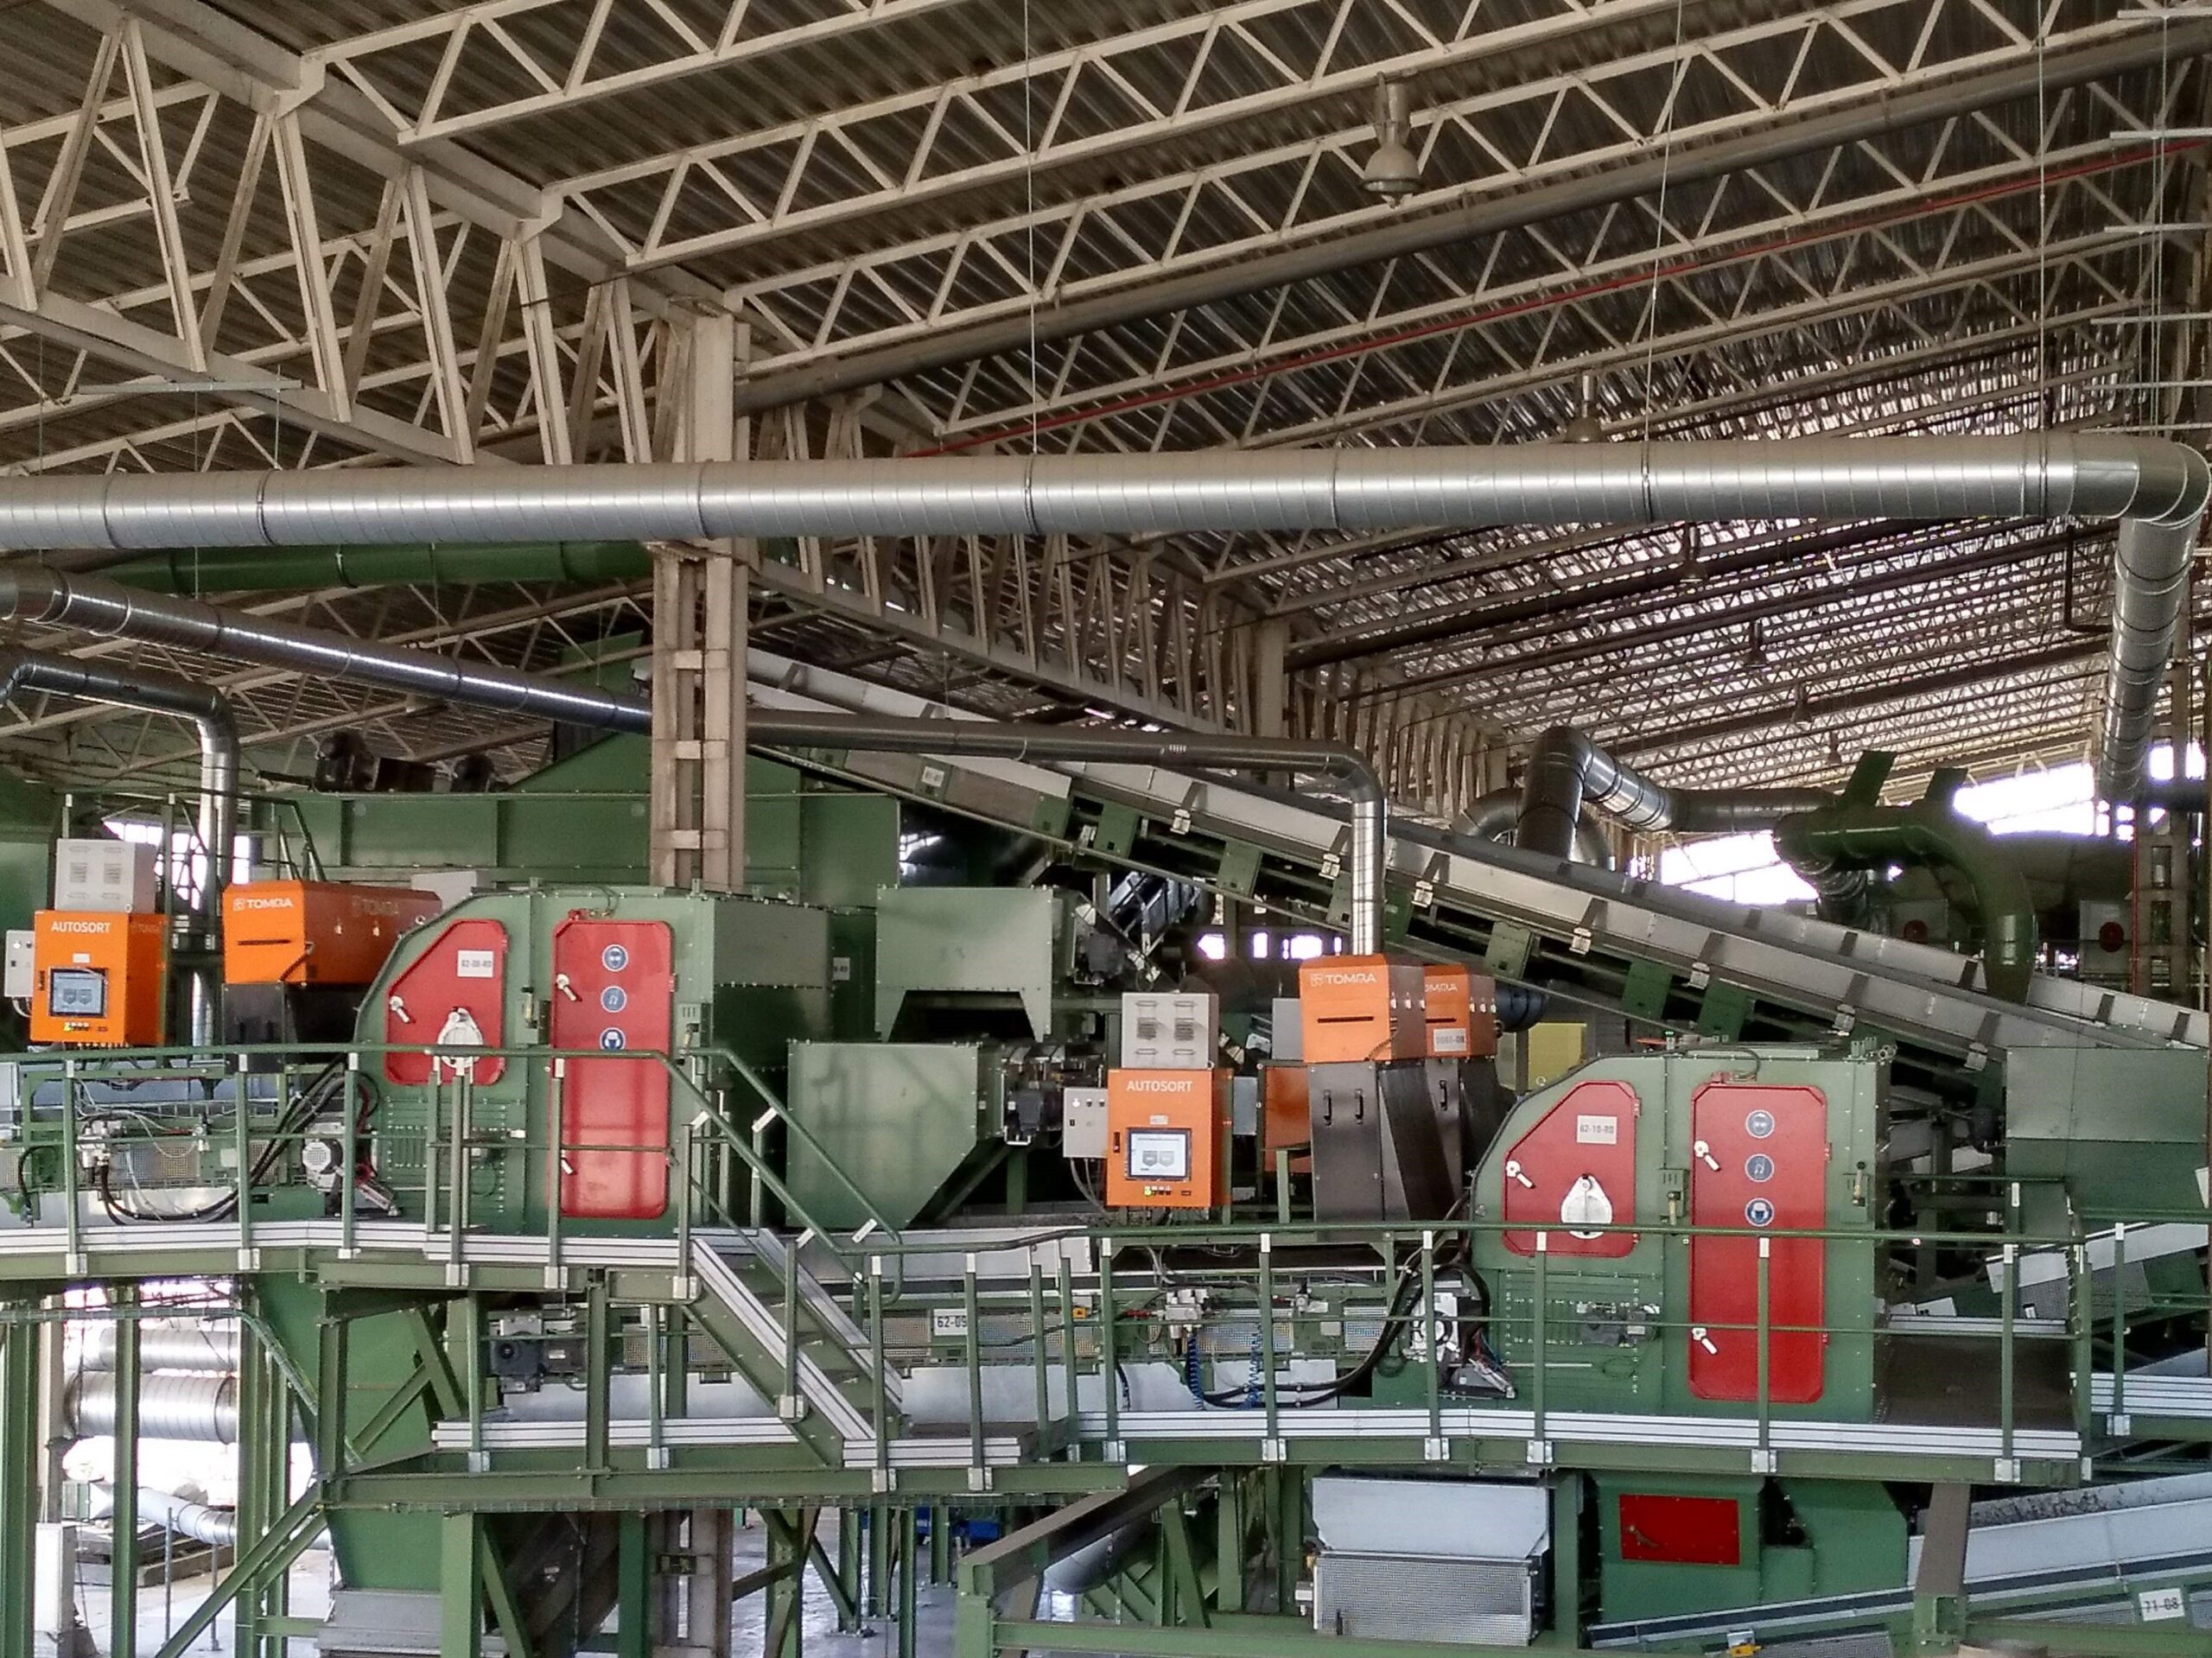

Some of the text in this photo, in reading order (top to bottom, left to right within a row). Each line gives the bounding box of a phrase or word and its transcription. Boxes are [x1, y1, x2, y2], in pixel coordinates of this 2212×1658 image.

[246, 899, 293, 909] TOMRA
[51, 921, 111, 933] AUTOSORT
[1325, 972, 1376, 984] TOMRA
[1425, 982, 1459, 993] OMRA
[1126, 1080, 1193, 1092] AUTOSORT
